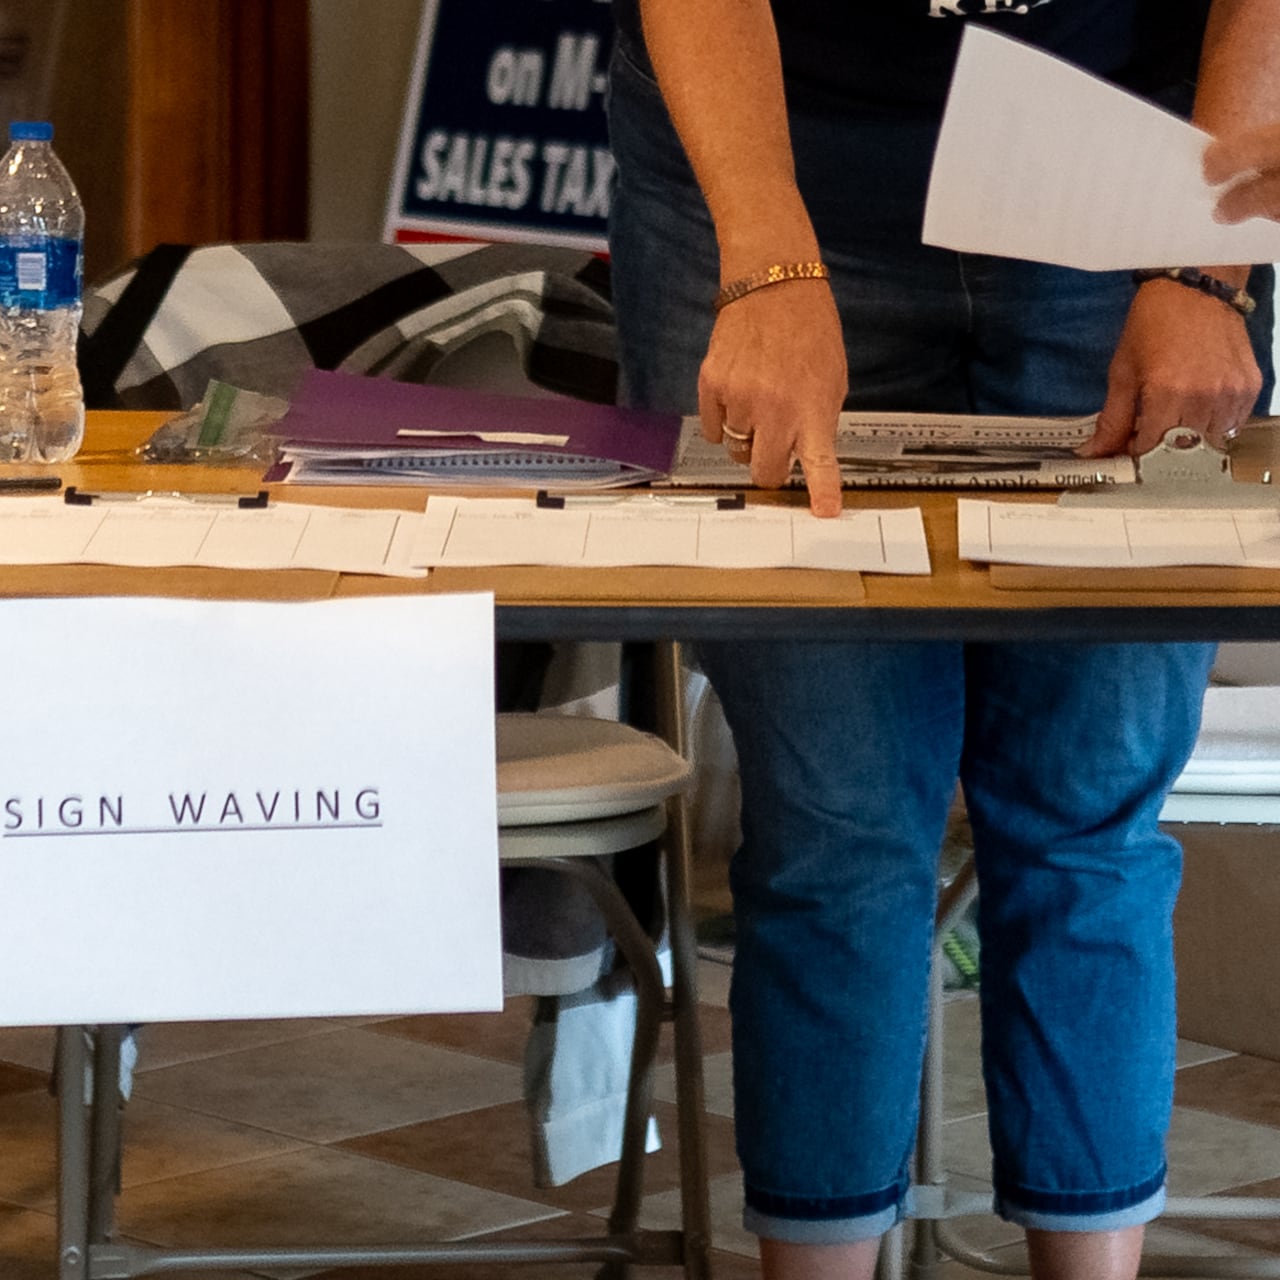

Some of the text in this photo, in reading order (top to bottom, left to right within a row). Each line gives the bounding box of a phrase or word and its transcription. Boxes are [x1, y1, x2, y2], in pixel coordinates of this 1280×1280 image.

[486, 47, 544, 106] on
[417, 128, 616, 218] SALES TAX
[973, 428, 1083, 438] Journal
[4, 787, 381, 830] SIGN WAVING
